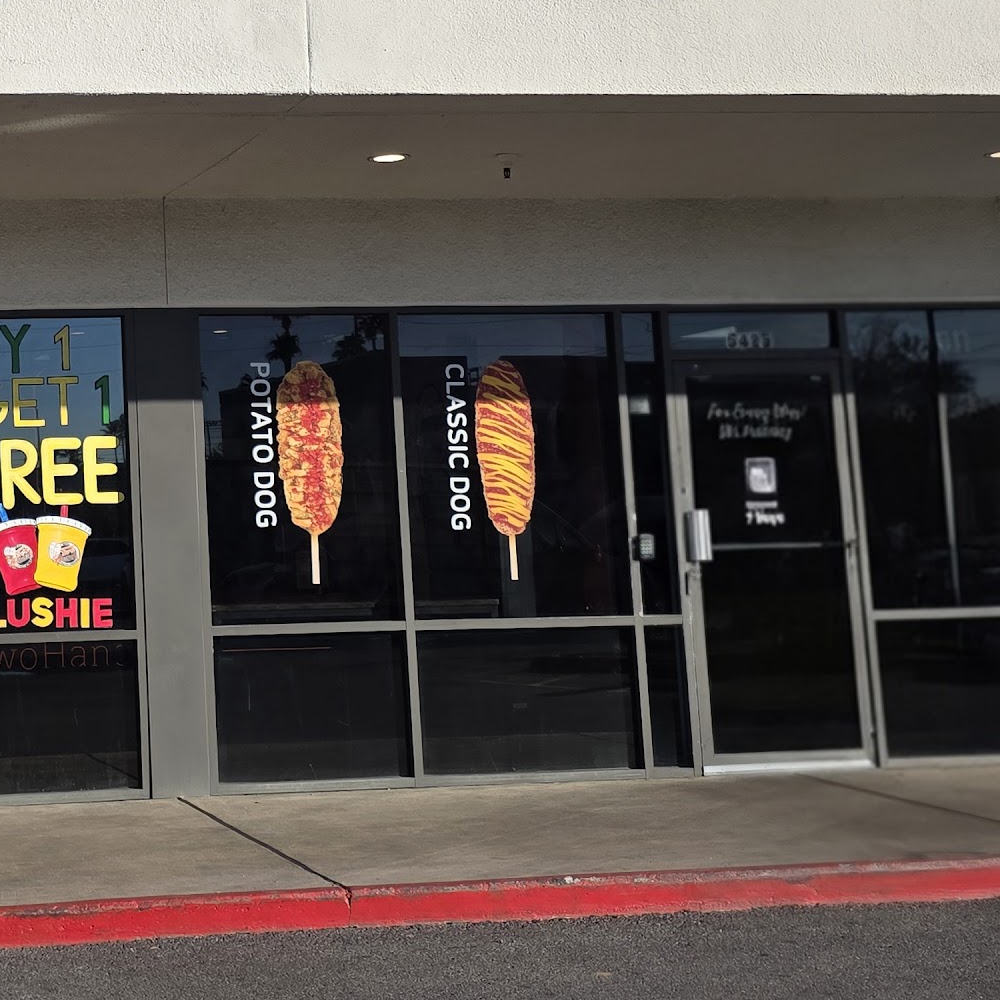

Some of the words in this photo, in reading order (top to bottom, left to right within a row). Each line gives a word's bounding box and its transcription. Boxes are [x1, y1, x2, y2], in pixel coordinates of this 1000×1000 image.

[53, 325, 72, 371] 1
[94, 375, 112, 425] 1
[250, 361, 275, 464] POTATO
[444, 363, 470, 470] CLASSIC
[253, 471, 278, 529] DOG
[449, 477, 473, 532] DOG
